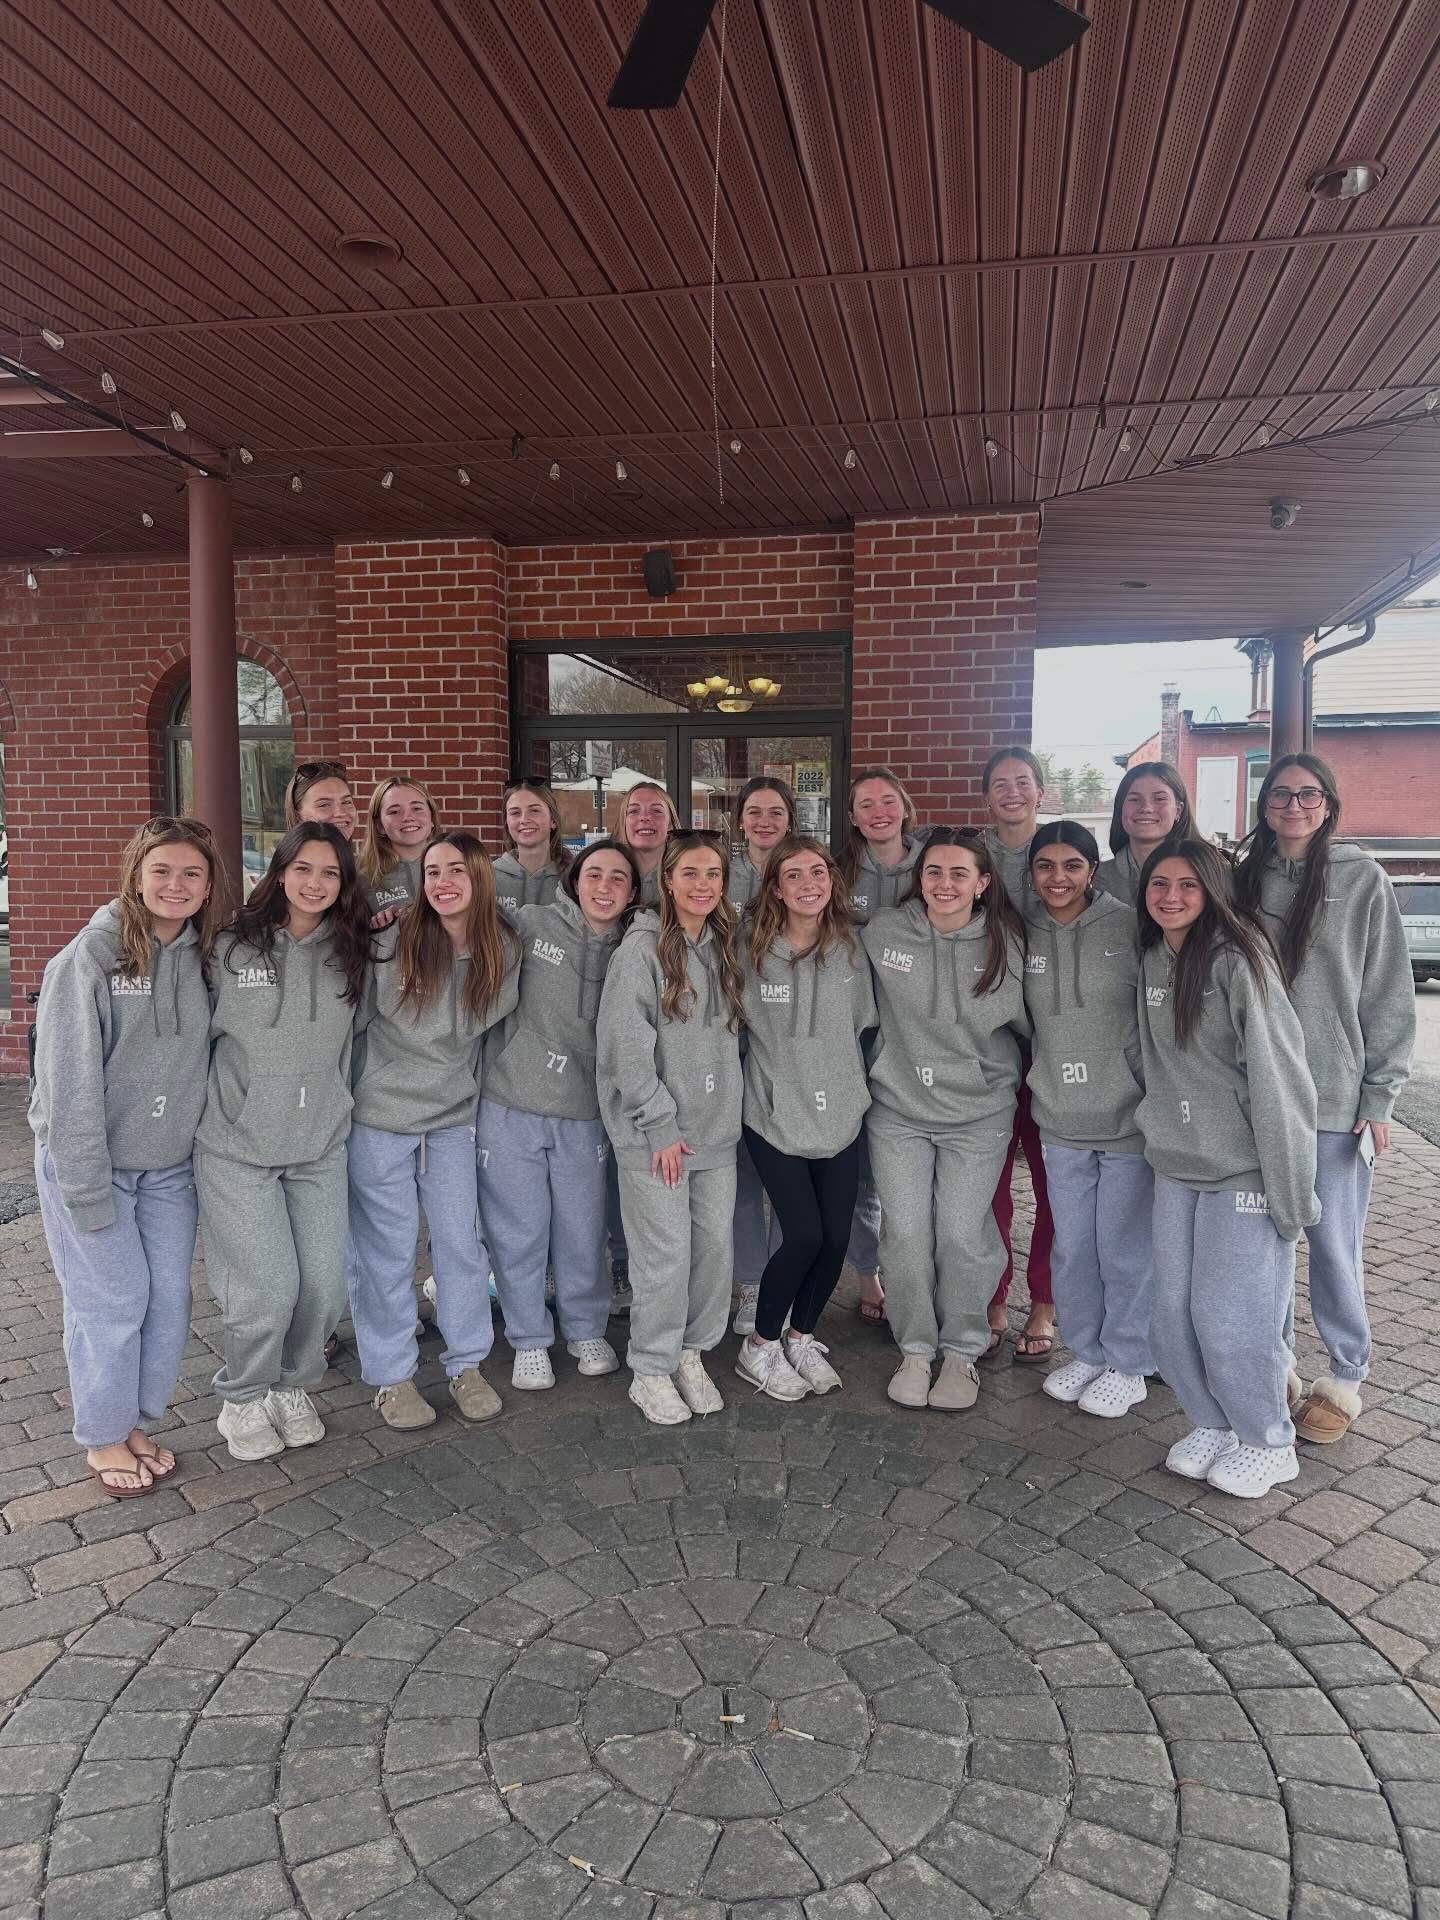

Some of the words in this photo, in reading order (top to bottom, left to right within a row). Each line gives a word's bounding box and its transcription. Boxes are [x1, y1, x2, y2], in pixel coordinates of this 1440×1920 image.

[797, 771, 823, 780] 2022
[797, 784, 823, 792] BEST
[532, 938, 566, 961] RAMS
[882, 947, 913, 968] RAMS
[111, 975, 151, 990] RAMS
[238, 967, 277, 983] RAMS
[760, 983, 790, 998] RAMS
[1061, 1062, 1088, 1083] 20
[705, 1073, 715, 1094] 6
[151, 1095, 167, 1118] 3
[299, 1087, 306, 1108] 1
[814, 1090, 827, 1111] 5
[1235, 1191, 1270, 1209] RAM
